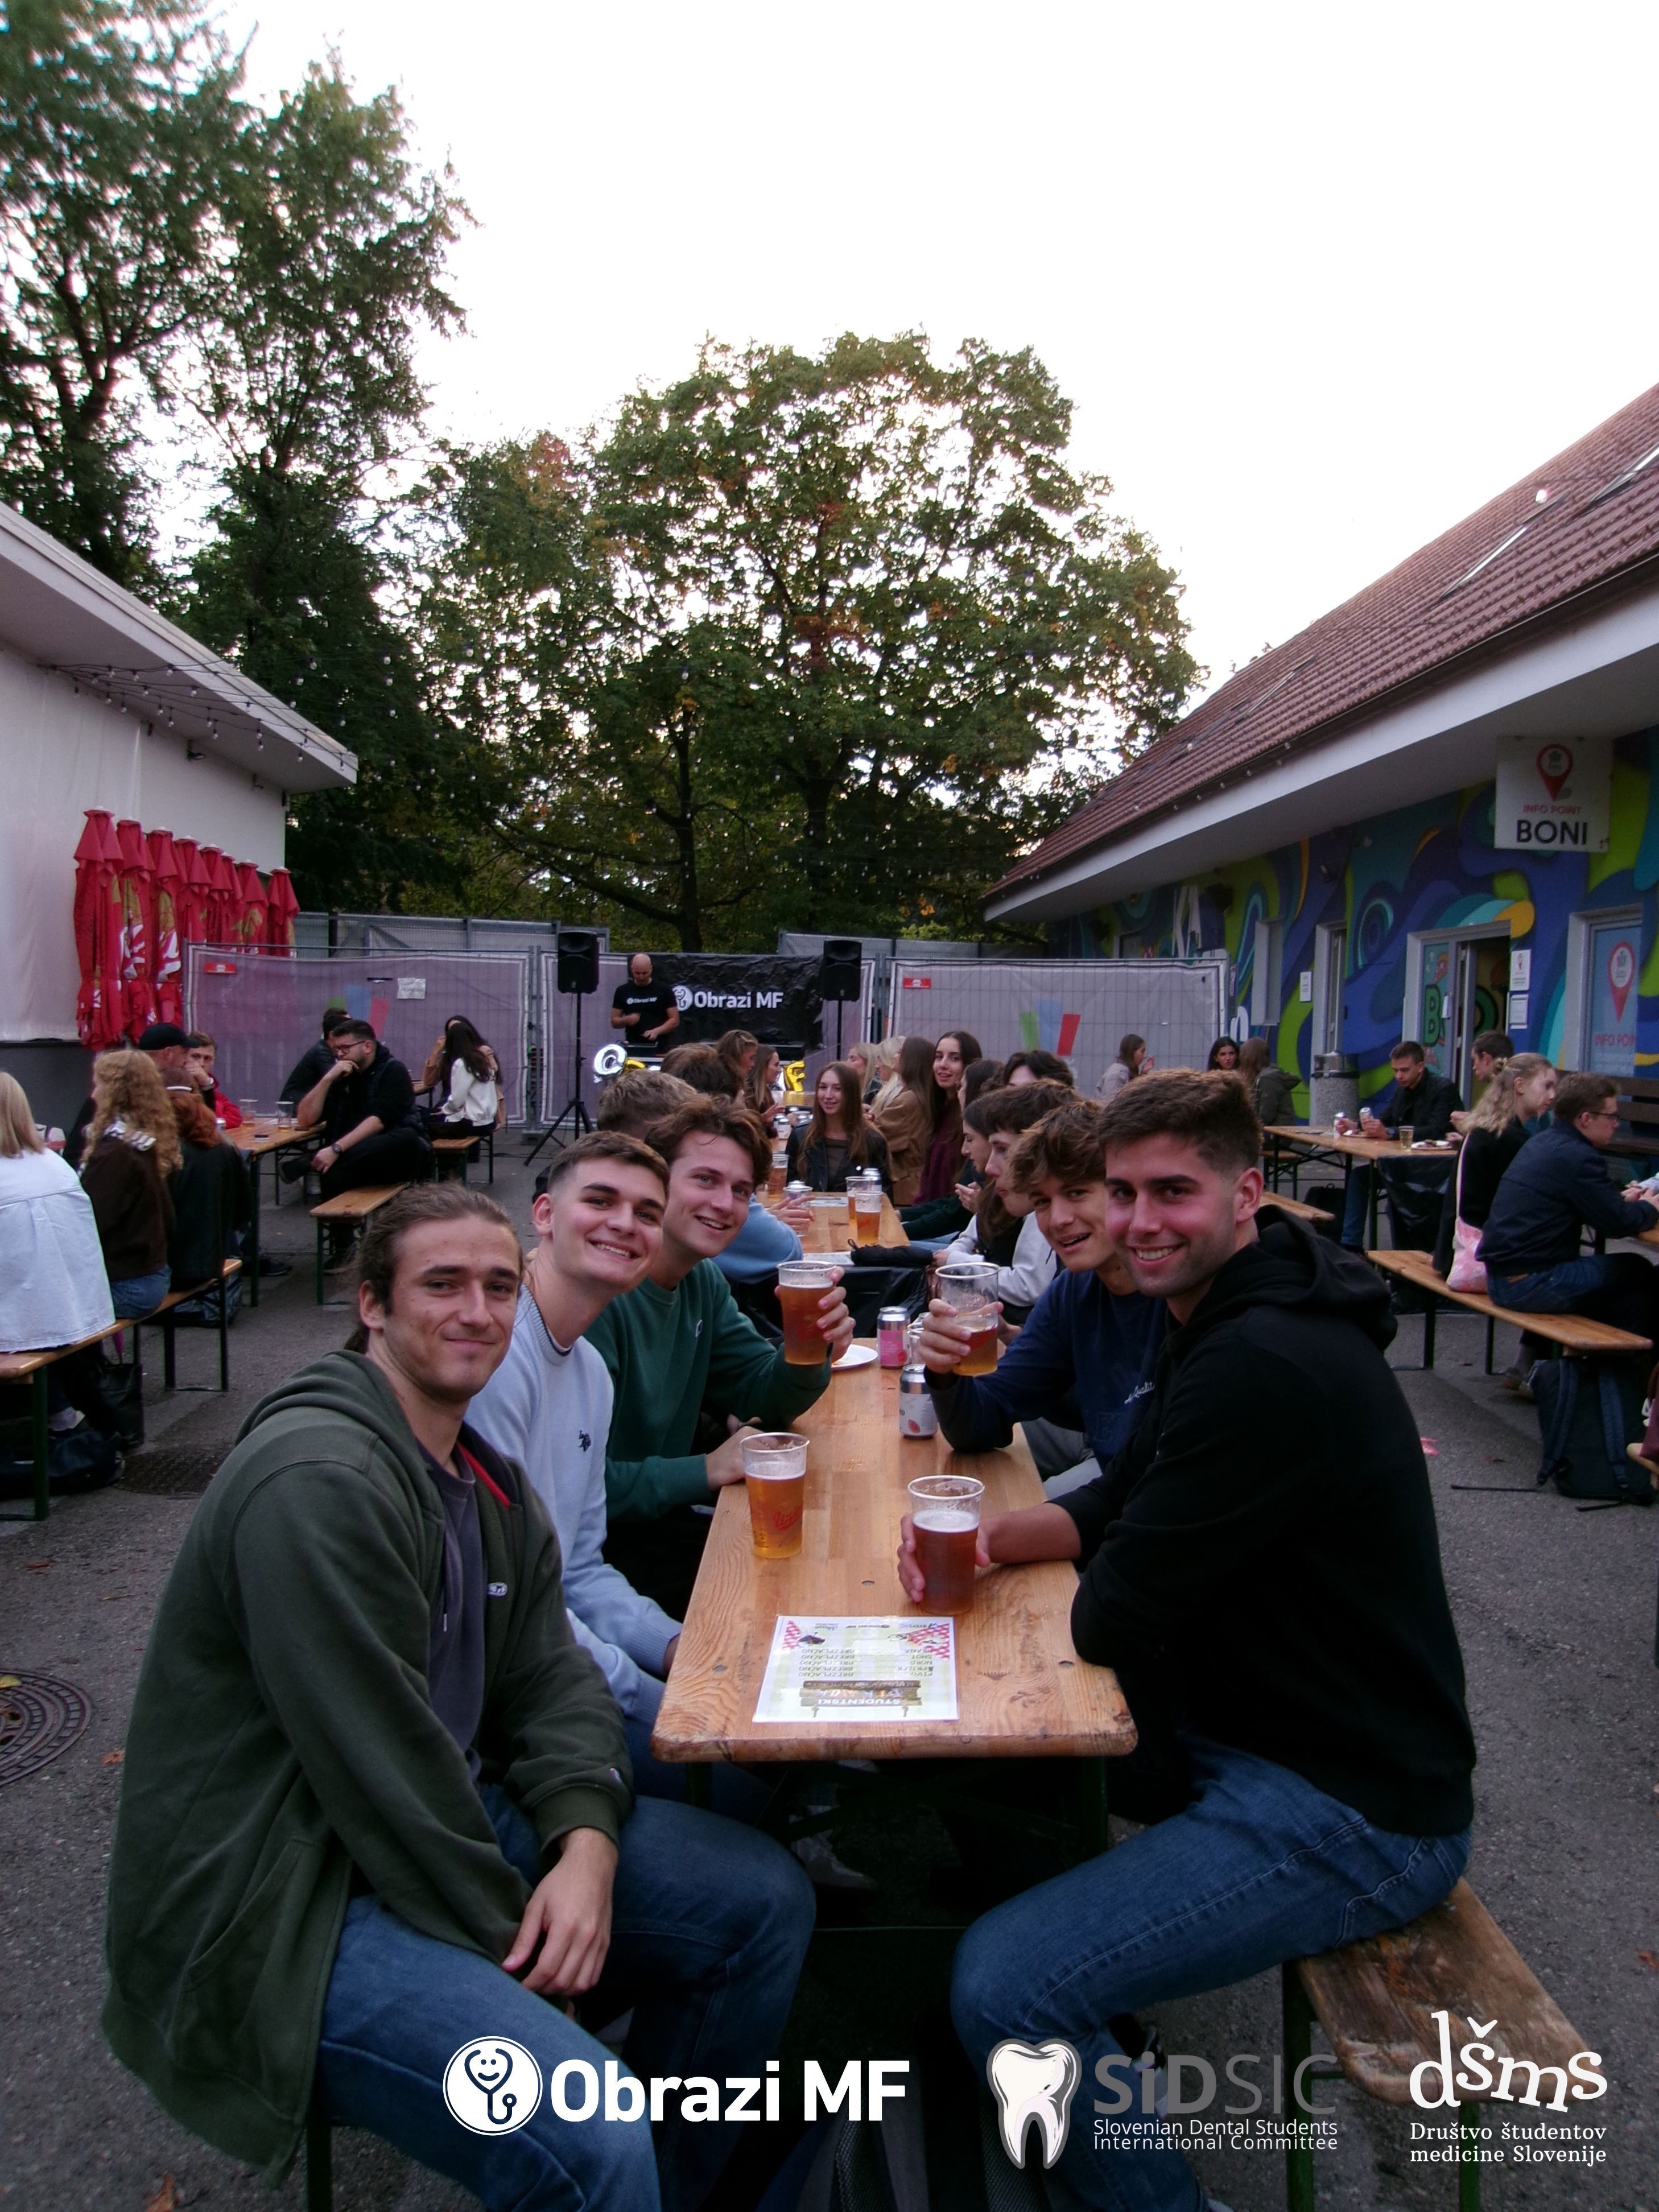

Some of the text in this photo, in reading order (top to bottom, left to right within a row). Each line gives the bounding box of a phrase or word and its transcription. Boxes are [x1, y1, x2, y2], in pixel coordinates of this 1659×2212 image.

[1523, 804, 1581, 814] INFO POINT
[1516, 819, 1587, 845] BONI
[694, 991, 783, 1008] Obrazi MF
